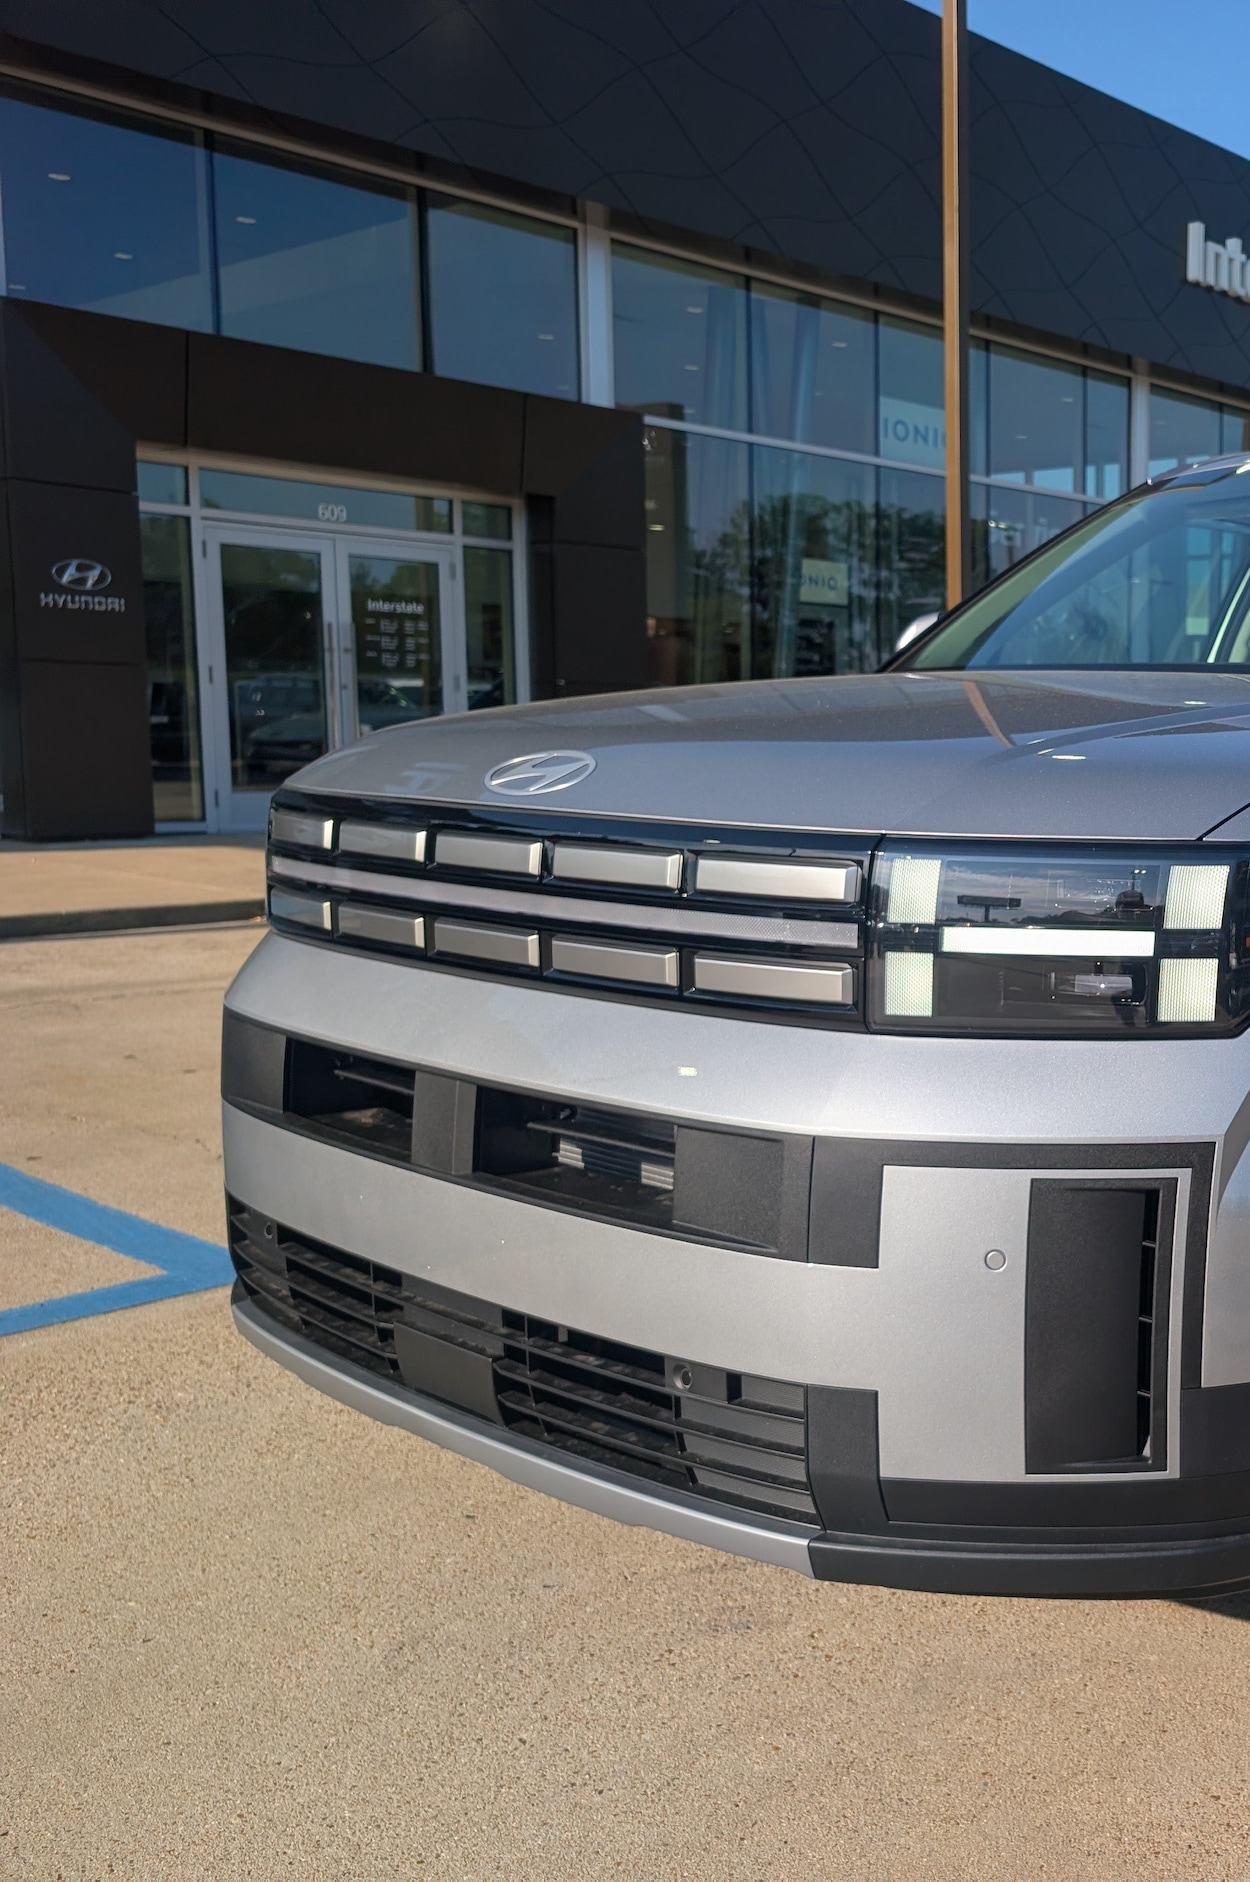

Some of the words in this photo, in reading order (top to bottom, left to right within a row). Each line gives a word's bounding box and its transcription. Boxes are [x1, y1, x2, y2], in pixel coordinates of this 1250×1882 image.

[883, 416, 946, 449] IONI
[318, 502, 347, 522] 609
[40, 592, 126, 612] HYUNDAI
[367, 598, 425, 615] Interstate
